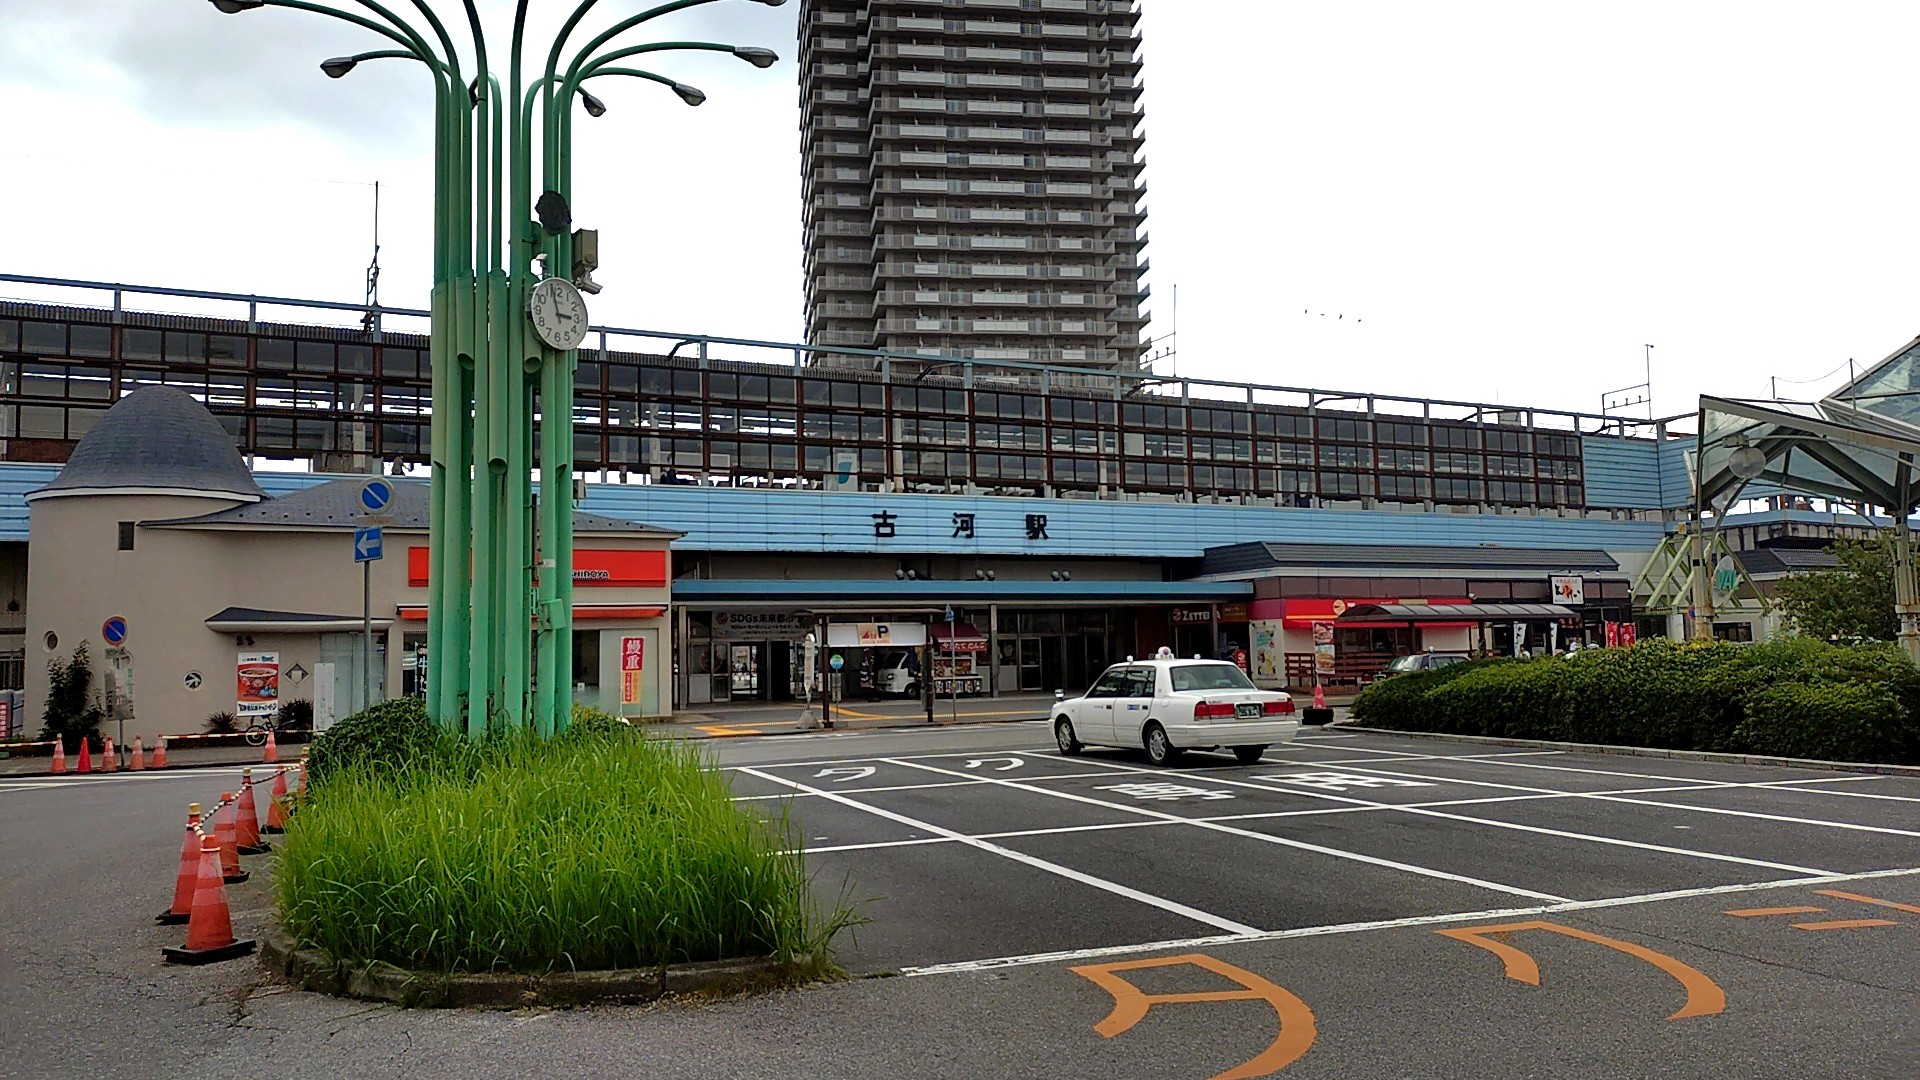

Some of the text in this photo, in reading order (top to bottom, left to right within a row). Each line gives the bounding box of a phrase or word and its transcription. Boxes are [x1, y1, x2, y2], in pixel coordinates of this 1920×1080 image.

[536, 293, 546, 305] 10
[566, 292, 569, 301] 1
[534, 305, 541, 315] 9
[571, 301, 577, 312] 2
[538, 316, 545, 327] 8
[574, 314, 580, 324] 3
[545, 327, 552, 337] 7
[570, 325, 577, 335] 4
[554, 332, 561, 342] 6
[563, 331, 570, 341] 5
[872, 510, 1049, 540] 古河駅
[572, 570, 609, 578] HINOYA
[625, 639, 642, 669] 鰻重
